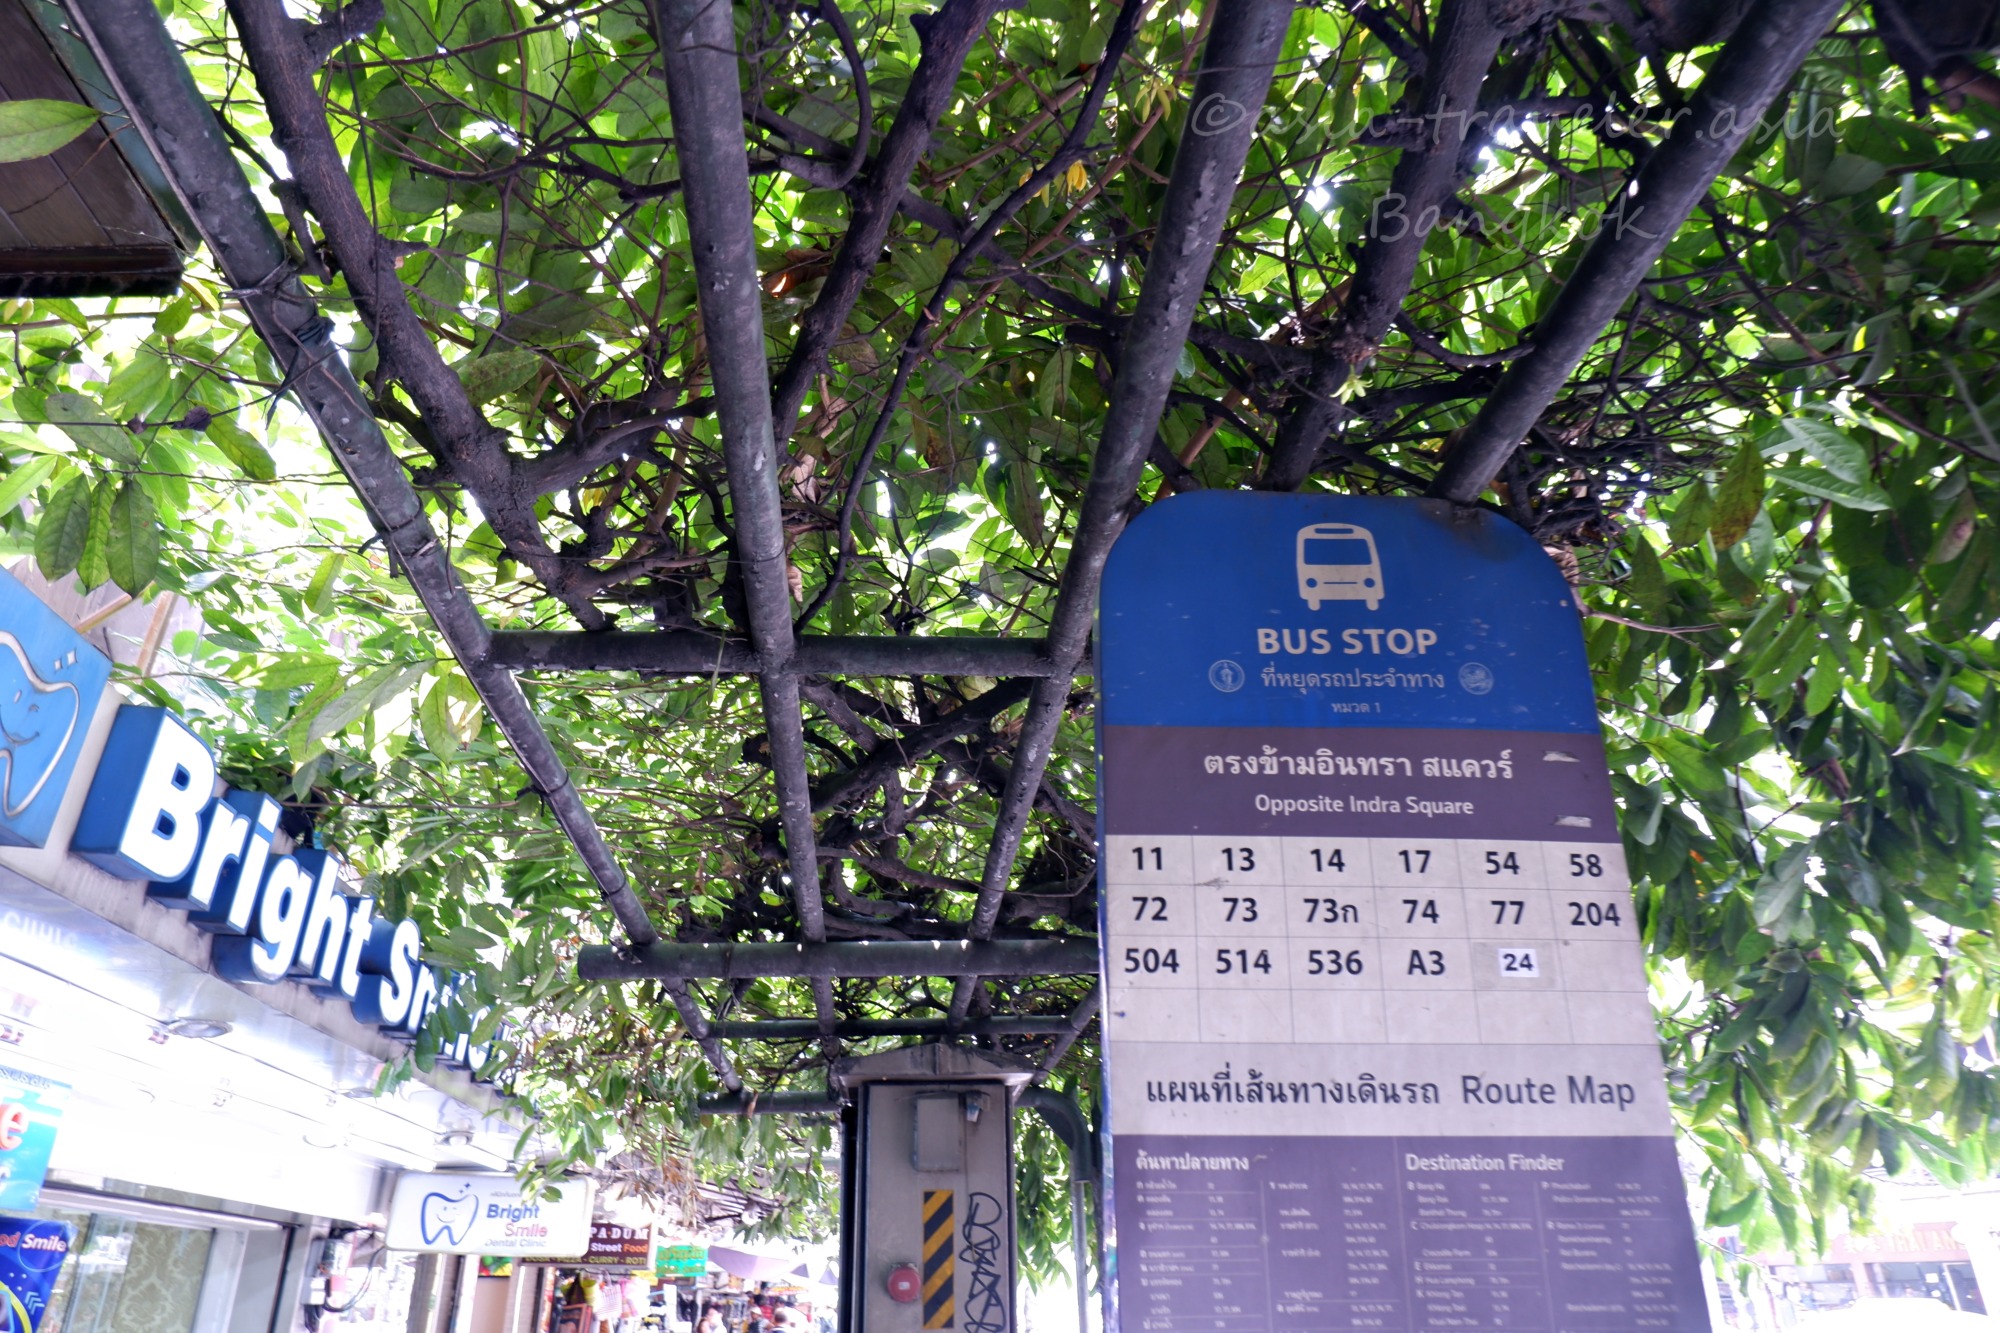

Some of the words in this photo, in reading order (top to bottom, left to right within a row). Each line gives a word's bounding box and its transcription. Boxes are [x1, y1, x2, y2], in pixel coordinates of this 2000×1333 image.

[1257, 628, 1332, 655] BUS
[1342, 628, 1438, 655] STOP
[1261, 661, 1445, 694] ที่หยุดรถประจำทาง
[1374, 701, 1382, 714] 1
[1203, 745, 1413, 776] ตรงข้ามอินทรา
[1421, 748, 1514, 778] สแควร์
[1255, 794, 1344, 815] Opposite
[1349, 796, 1401, 813] Indra
[1406, 796, 1474, 817] Square
[117, 708, 374, 1000] Bright
[1131, 847, 1164, 871] 11
[1221, 848, 1256, 873] 13
[1310, 848, 1345, 873] 14
[1398, 849, 1431, 874] 17
[1485, 851, 1520, 875] 54
[1569, 853, 1602, 877] 58
[1131, 896, 1168, 921] 72
[1222, 897, 1258, 922] 73
[1303, 898, 1359, 924] 73ก
[1402, 899, 1439, 924] 74
[1491, 900, 1525, 925] 77
[1569, 902, 1621, 927] 204
[1124, 948, 1180, 974] 504
[1215, 949, 1272, 975] 514
[1307, 949, 1363, 975] 536
[1407, 950, 1446, 976] A3
[1503, 953, 1535, 972] 24
[1147, 1062, 1440, 1104] แผนที่เส้นทางเดินรถ
[1461, 1075, 1555, 1105] Route
[1568, 1076, 1636, 1112] Map
[1405, 1152, 1505, 1171] Destination
[1509, 1153, 1564, 1171] Finder
[486, 1204, 540, 1222] Bright
[22, 1233, 67, 1252] Smile
[504, 1223, 548, 1237] Smile
[588, 1256, 619, 1265] CURRY
[591, 1242, 622, 1253] Street
[623, 1243, 649, 1254] Food
